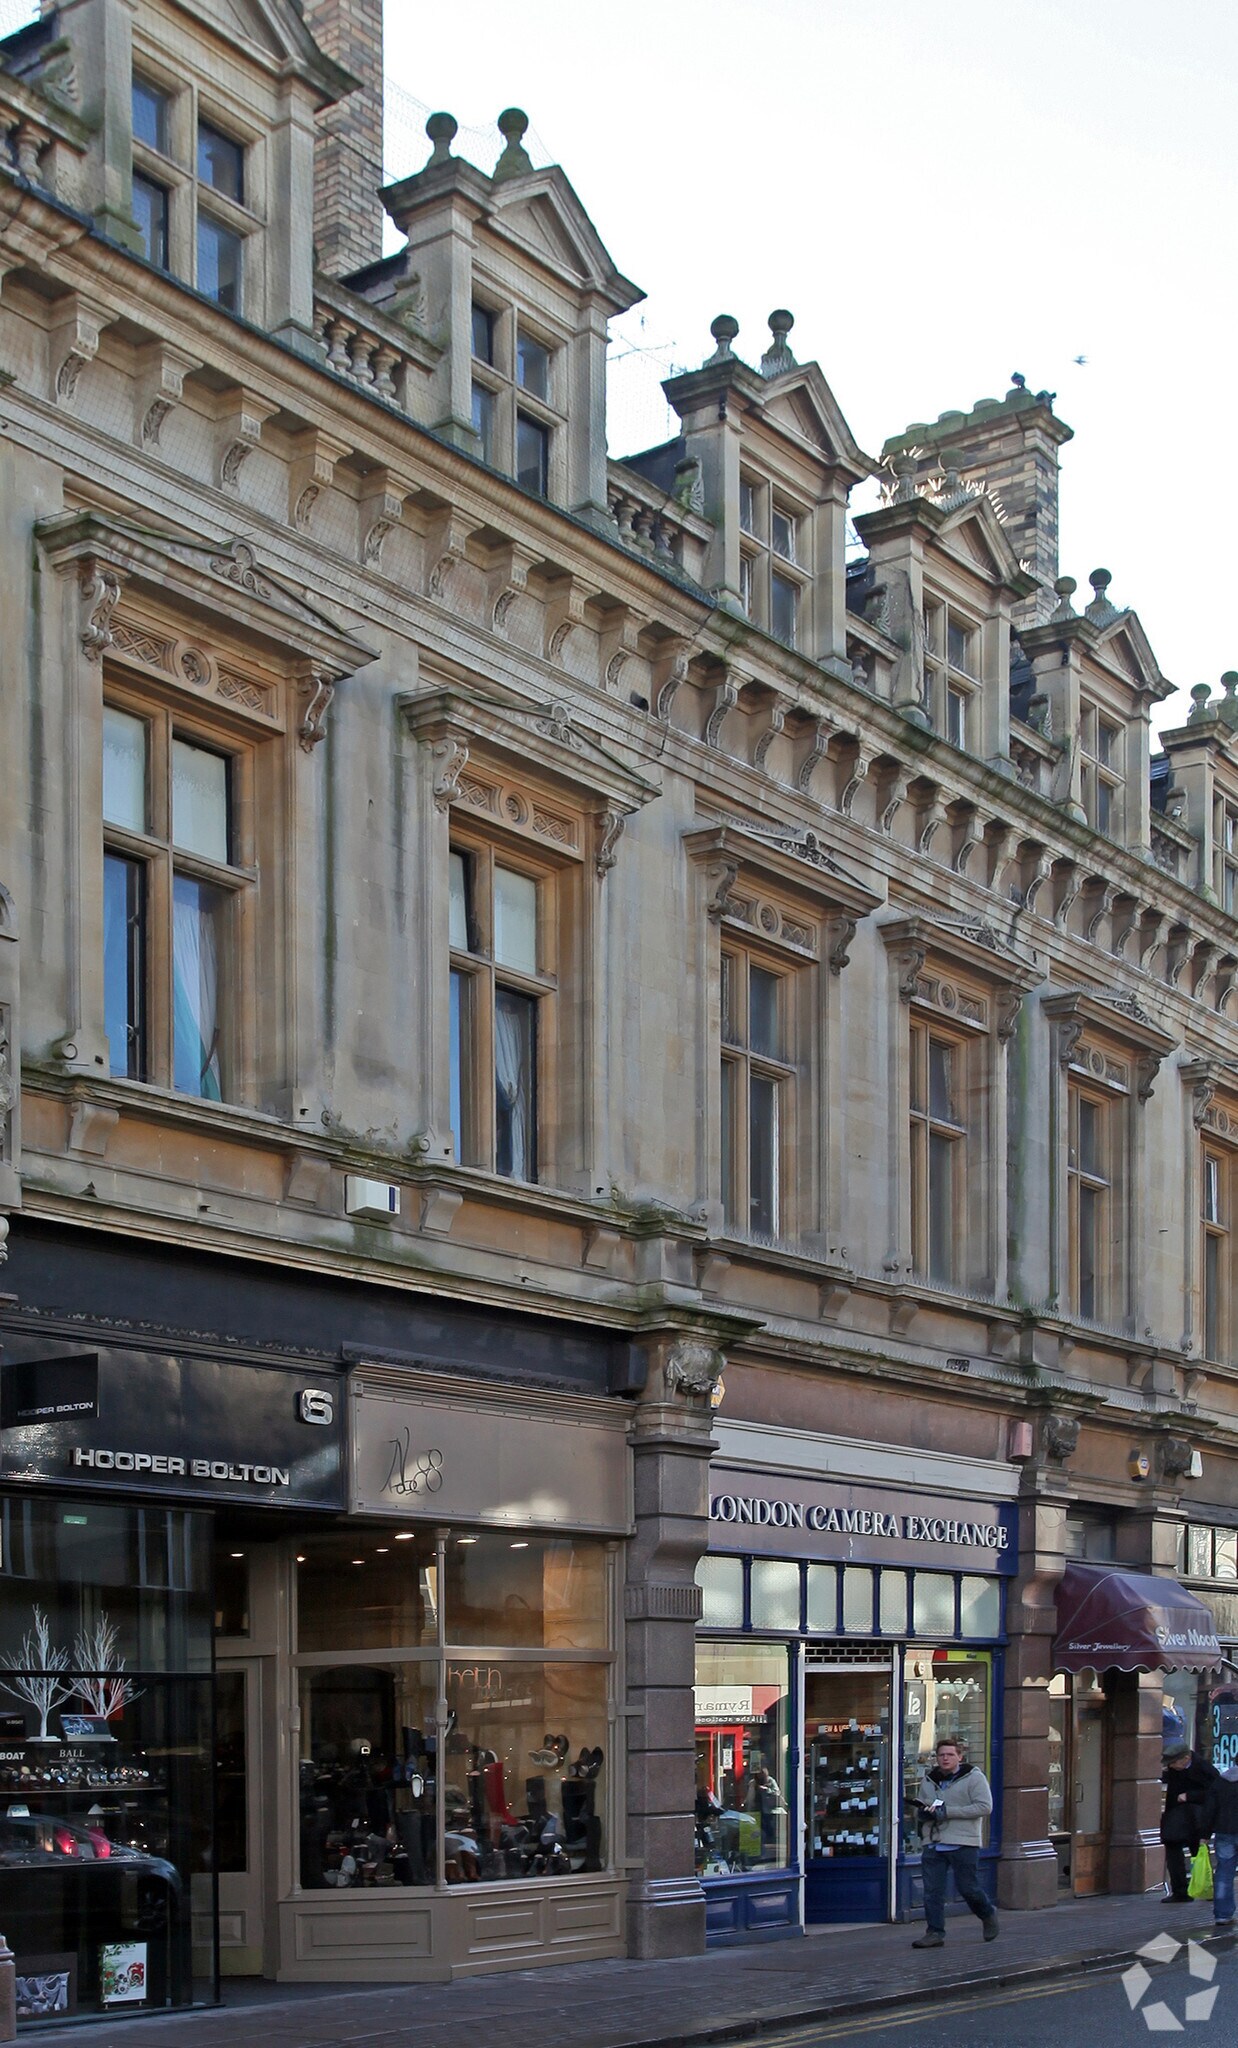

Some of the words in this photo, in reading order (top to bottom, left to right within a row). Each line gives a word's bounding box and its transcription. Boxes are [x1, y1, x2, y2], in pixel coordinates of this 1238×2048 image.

[18, 1406, 54, 1416] HOOPER
[57, 1402, 94, 1412] BOLTON
[301, 1389, 333, 1425] 6
[75, 1447, 185, 1475] HOOPER
[191, 1459, 290, 1485] BOLTON
[708, 1494, 805, 1527] LONDON
[812, 1505, 900, 1537] CAMERA
[907, 1515, 1010, 1549] EXCHANGE
[1068, 1642, 1091, 1650] Silver
[1092, 1642, 1131, 1652] Jewellery
[1155, 1626, 1187, 1647] Silver
[1187, 1628, 1219, 1647] Moon
[1213, 1705, 1221, 1738] 3
[59, 1749, 86, 1758] BALL
